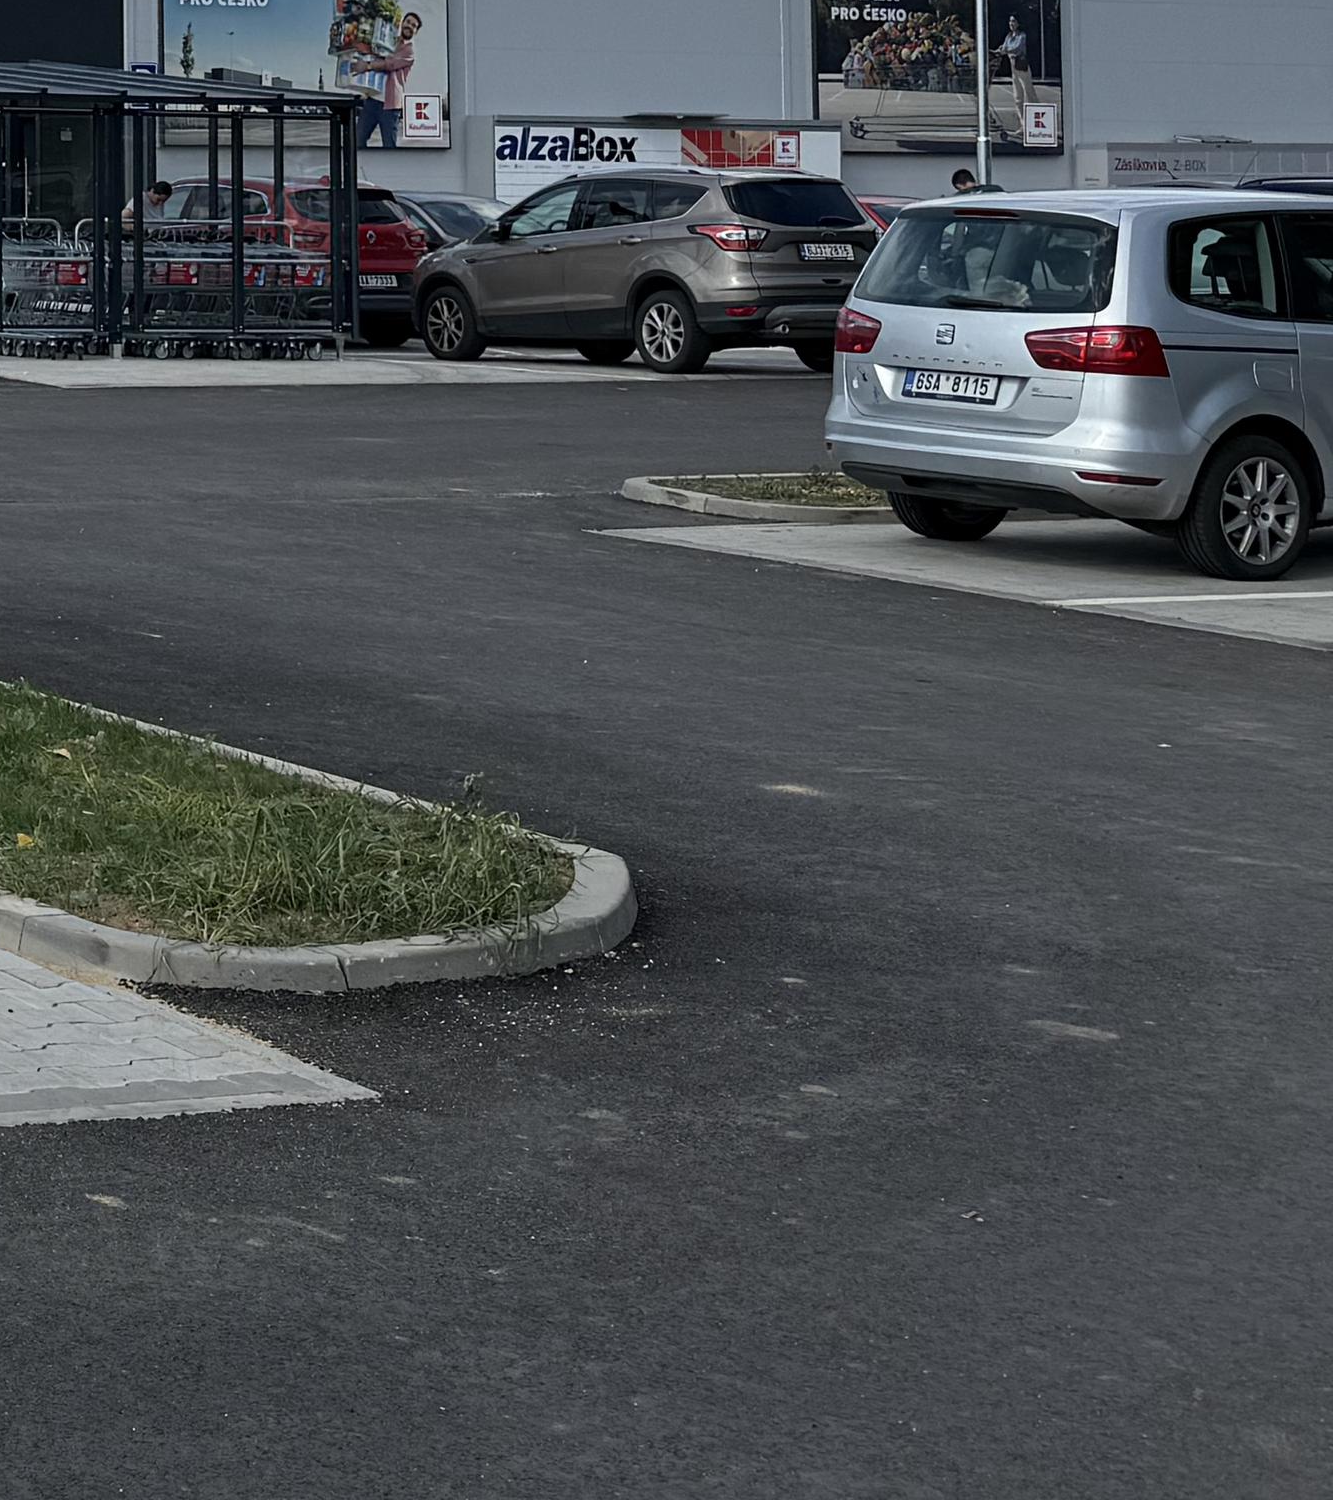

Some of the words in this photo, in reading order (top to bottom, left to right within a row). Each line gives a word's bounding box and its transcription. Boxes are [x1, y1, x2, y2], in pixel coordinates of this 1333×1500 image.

[830, 6, 860, 21] PRO
[862, 4, 908, 22] ČESKO
[495, 125, 639, 163] alzaBox
[1114, 157, 1167, 171] Zásilkovna
[916, 372, 941, 392] 6SA
[951, 376, 991, 396] 8115
